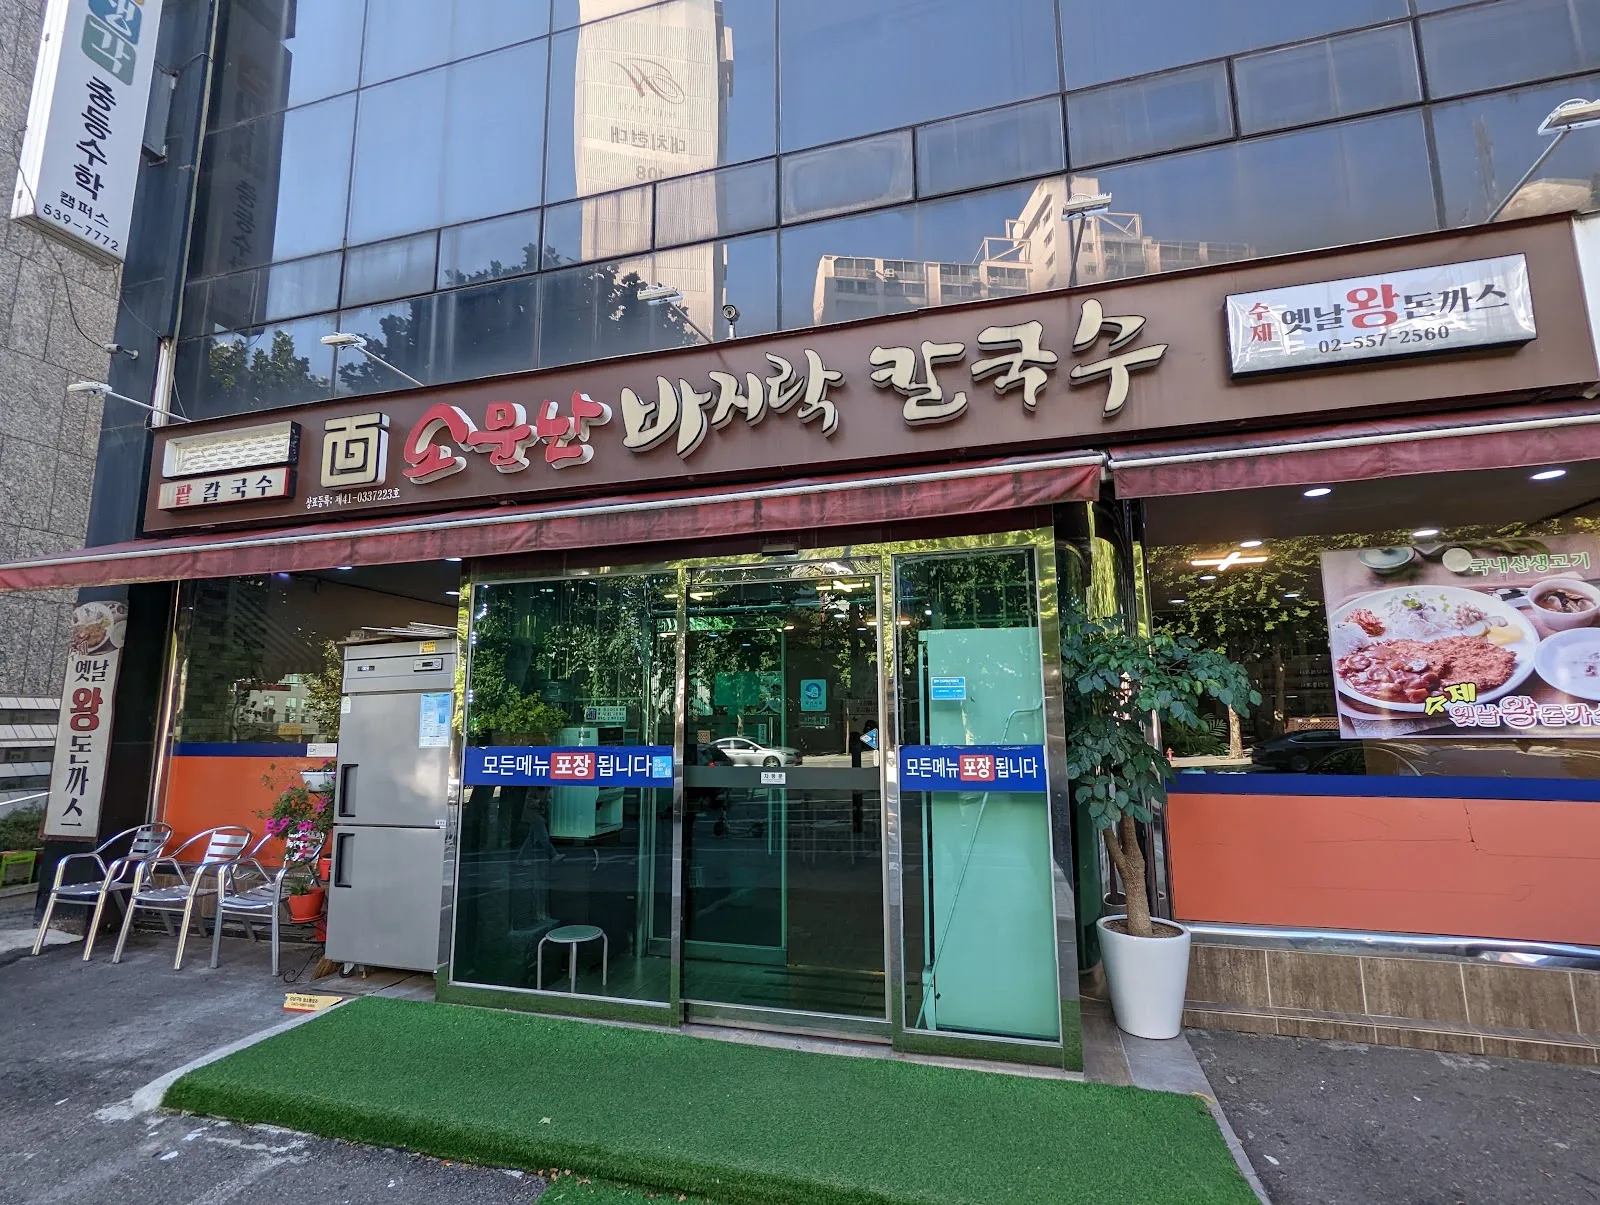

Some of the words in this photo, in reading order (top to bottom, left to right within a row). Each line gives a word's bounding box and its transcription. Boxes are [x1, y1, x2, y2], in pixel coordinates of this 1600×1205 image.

[74, 76, 117, 201] 중등수학
[43, 204, 119, 252] 539-7772
[60, 191, 111, 228] 캠퍼스
[1248, 302, 1273, 343] 수제
[1319, 325, 1450, 353] 02-557-2560
[403, 388, 612, 484] 소문난
[621, 348, 846, 459] 바지락
[868, 298, 1169, 426] 칼국수
[482, 755, 549, 777] 모든메뉴
[554, 754, 592, 777] 포장
[597, 754, 652, 777] 됩니다
[906, 757, 960, 779] 모든메뉴
[962, 757, 992, 778] 포장
[995, 757, 1038, 779] 됩니다
